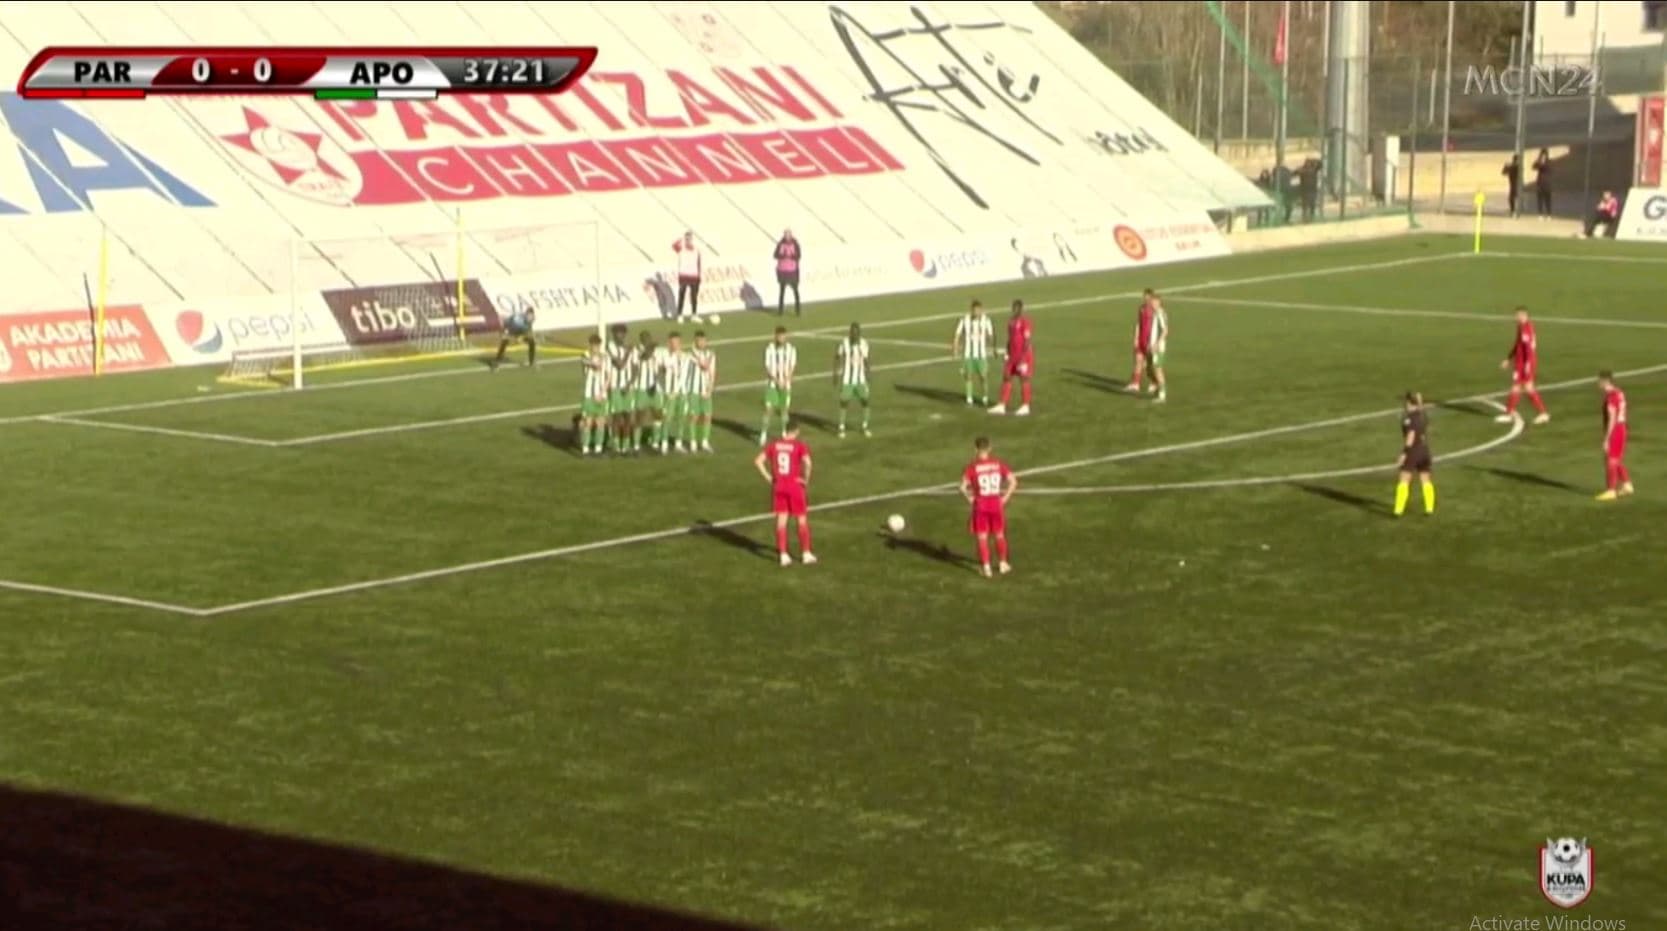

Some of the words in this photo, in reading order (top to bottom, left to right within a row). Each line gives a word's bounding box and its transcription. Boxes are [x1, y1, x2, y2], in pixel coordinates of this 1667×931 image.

[320, 65, 845, 141] PARTIZANI
[416, 136, 870, 196] CHANNEL
[351, 300, 416, 333] tibo
[776, 453, 791, 475] 9
[977, 473, 1002, 496] 99
